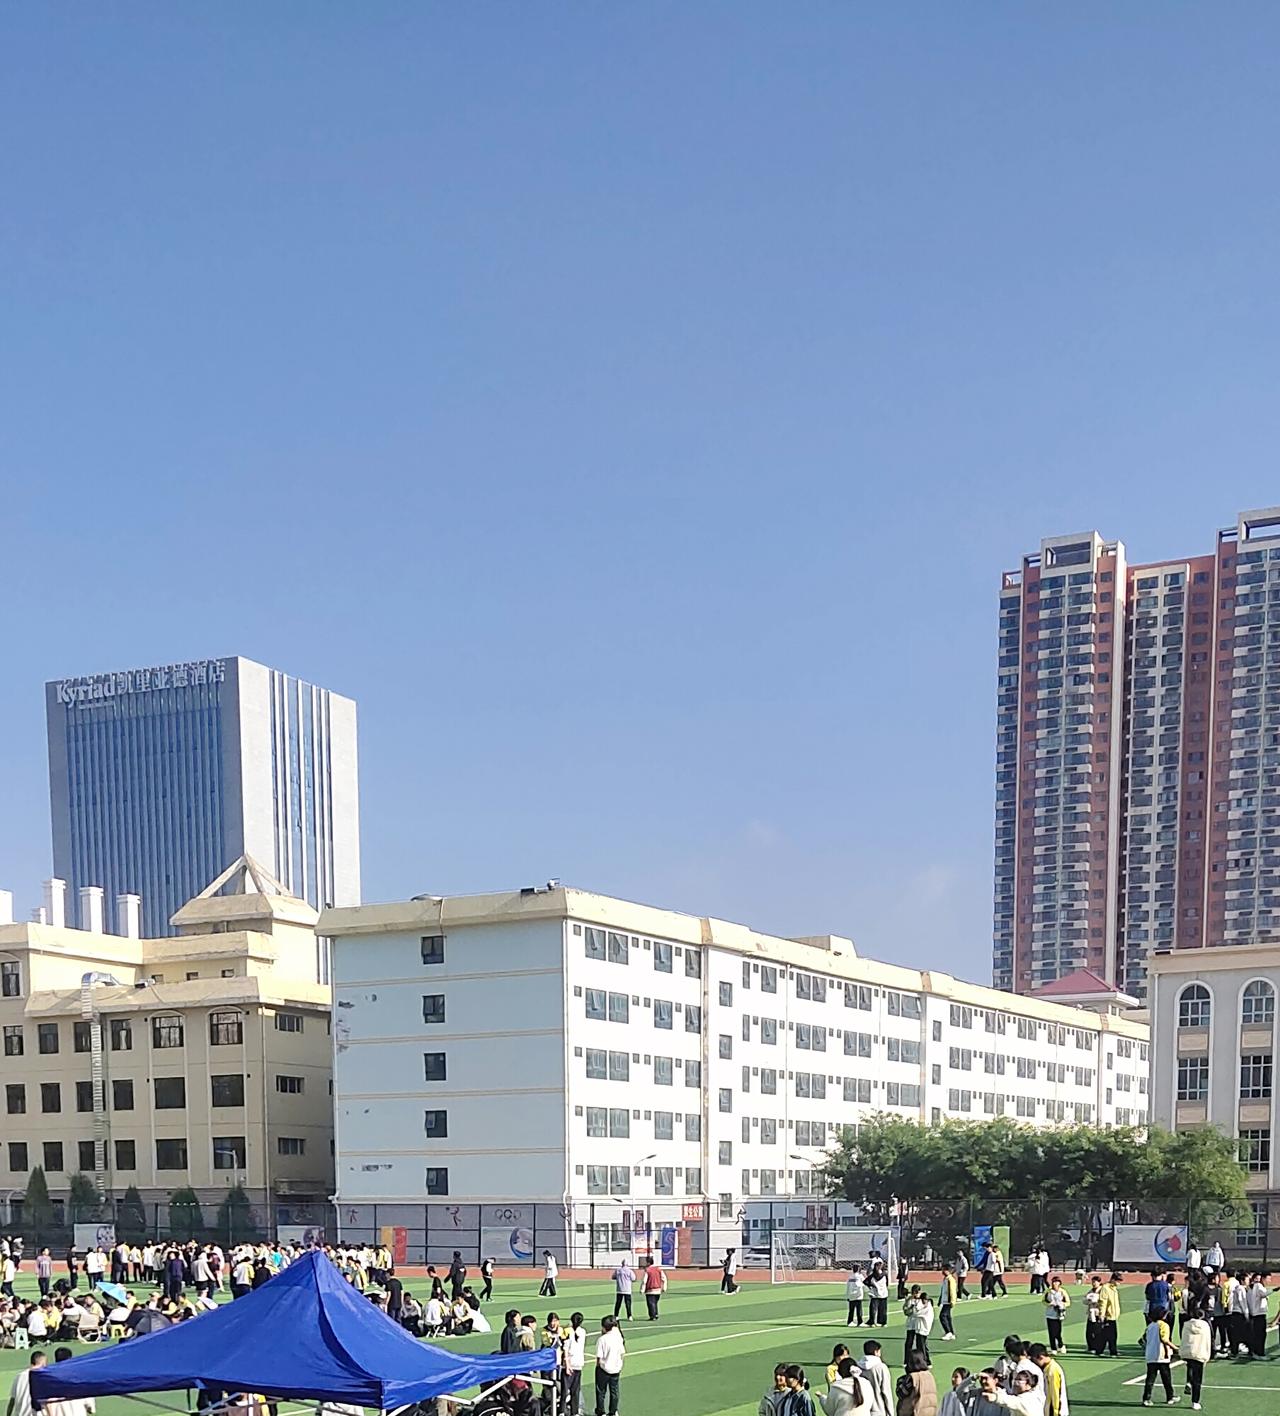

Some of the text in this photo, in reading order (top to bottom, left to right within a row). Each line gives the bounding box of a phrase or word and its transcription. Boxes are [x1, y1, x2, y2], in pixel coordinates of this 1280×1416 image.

[55, 673, 116, 708] Kyriad
[116, 661, 226, 694] 凯里亚德酒店
